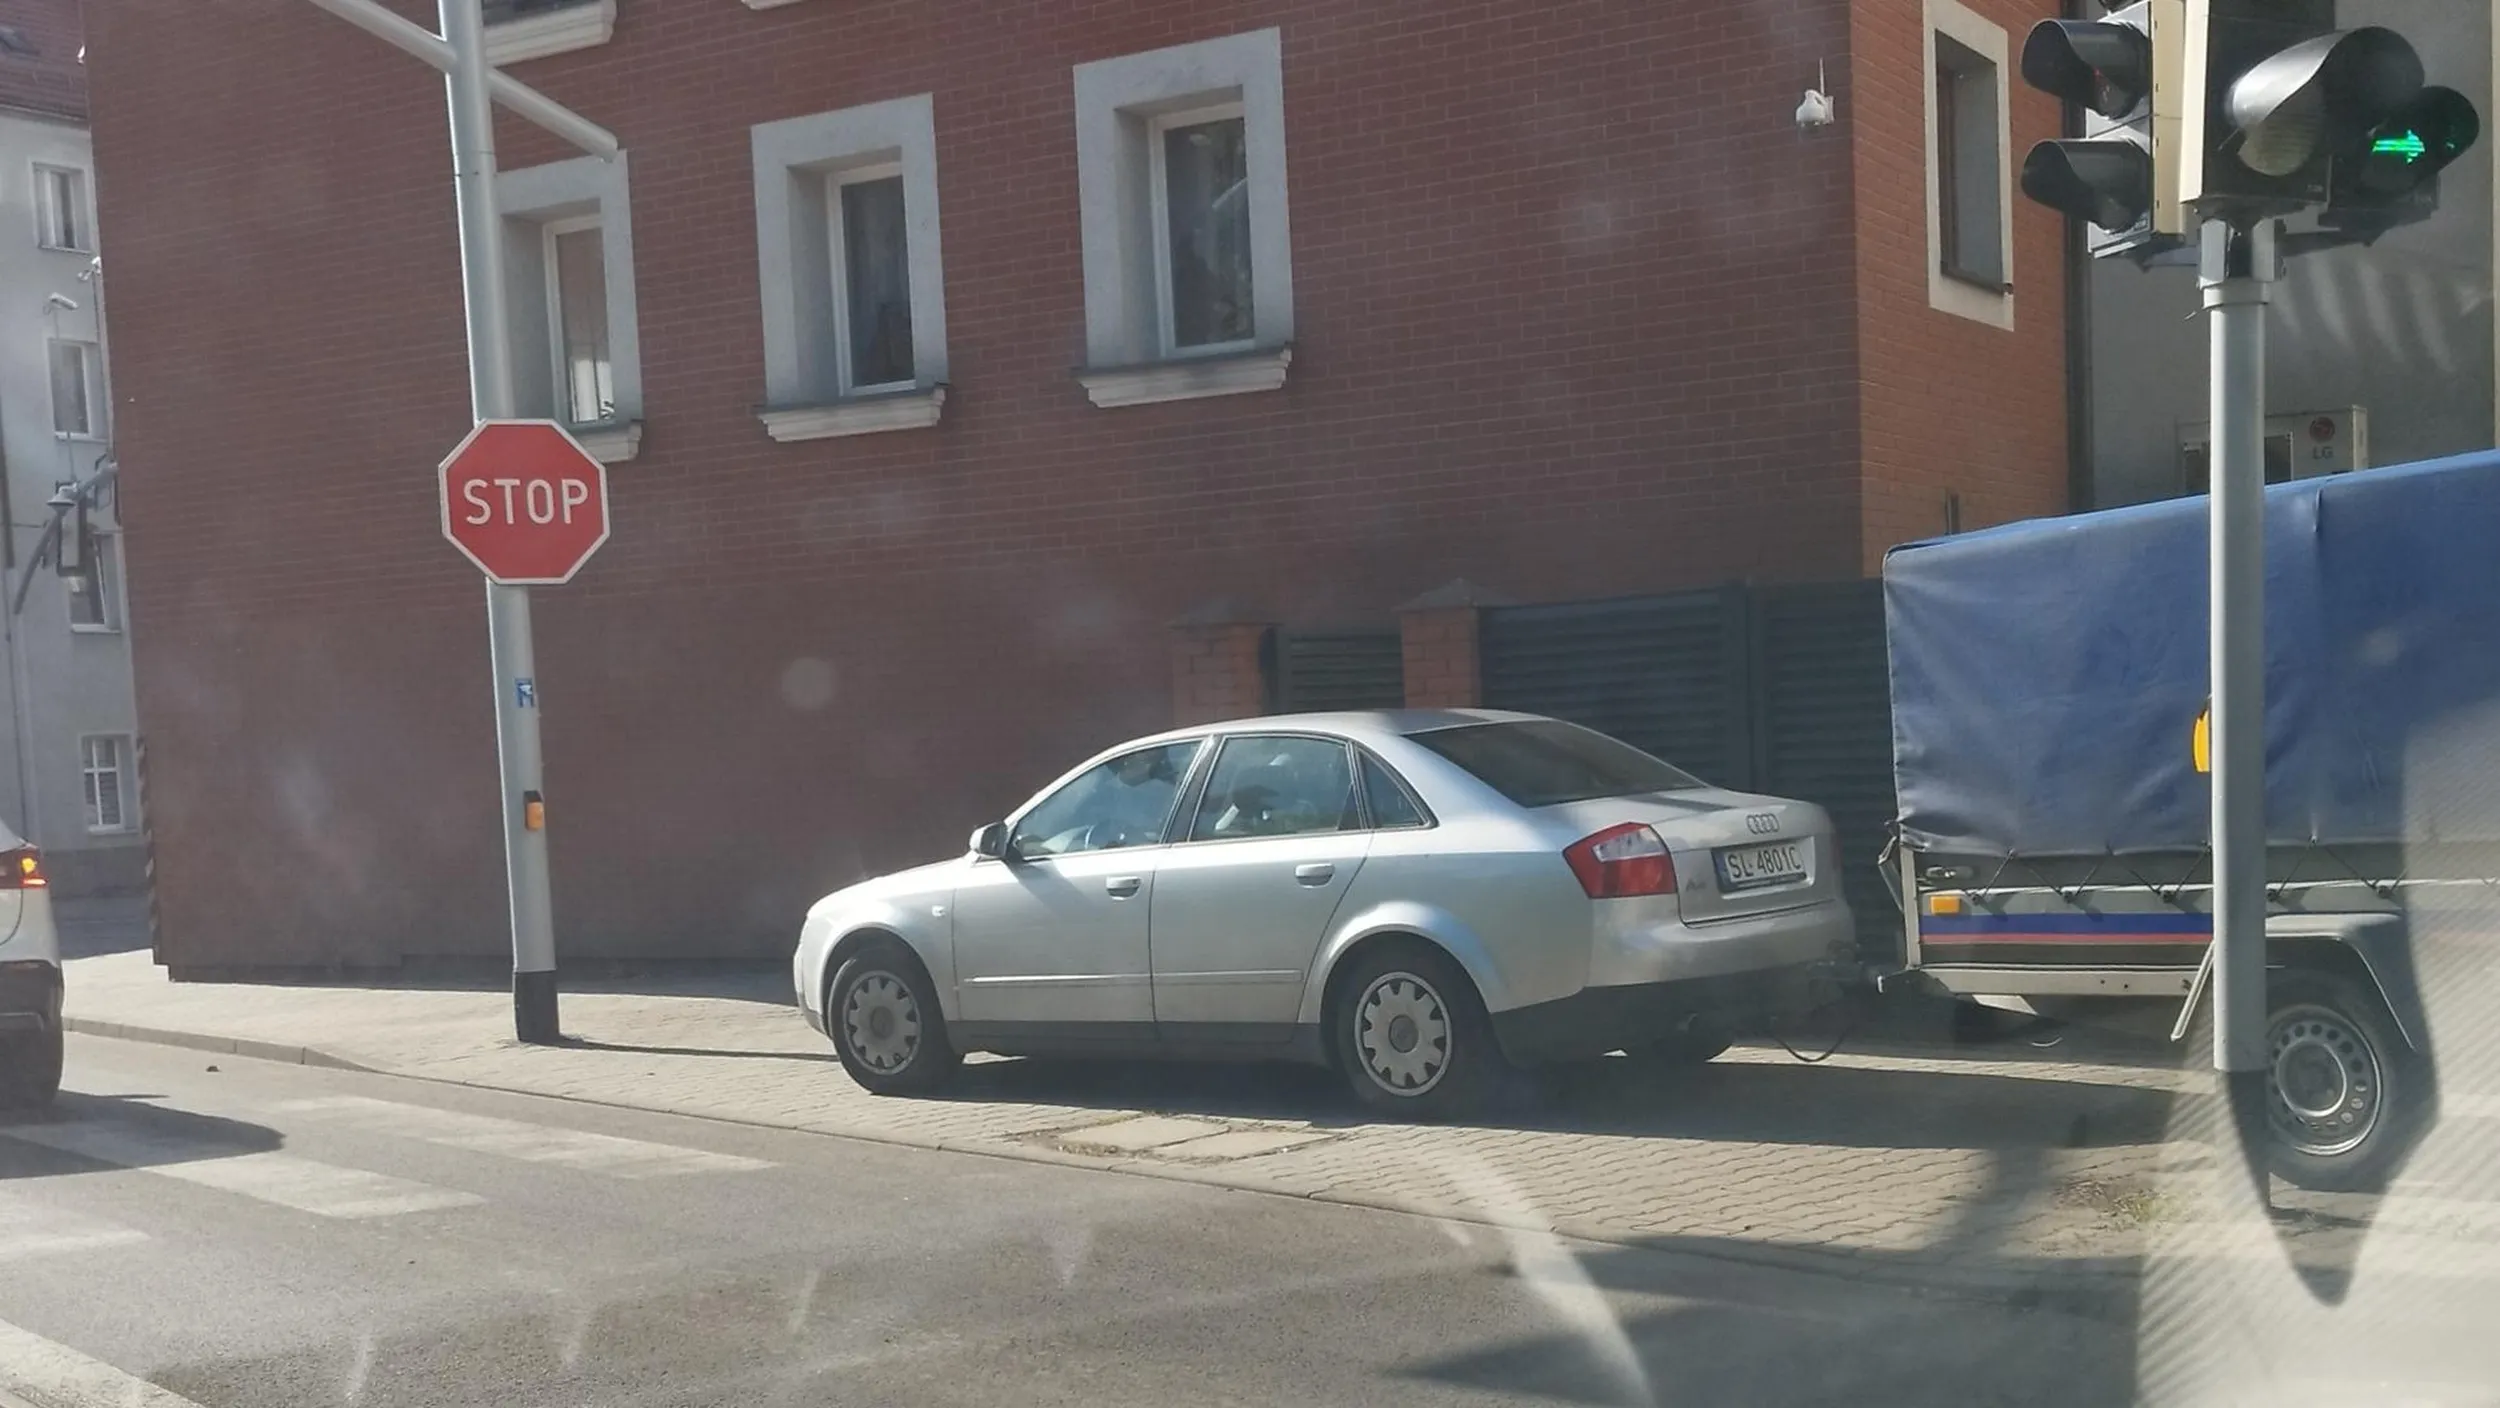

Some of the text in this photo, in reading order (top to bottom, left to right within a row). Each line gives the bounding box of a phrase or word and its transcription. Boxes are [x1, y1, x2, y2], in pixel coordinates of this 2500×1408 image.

[2313, 446, 2333, 460] LG
[463, 478, 589, 525] STOP
[1728, 846, 1801, 878] SL 4801C
